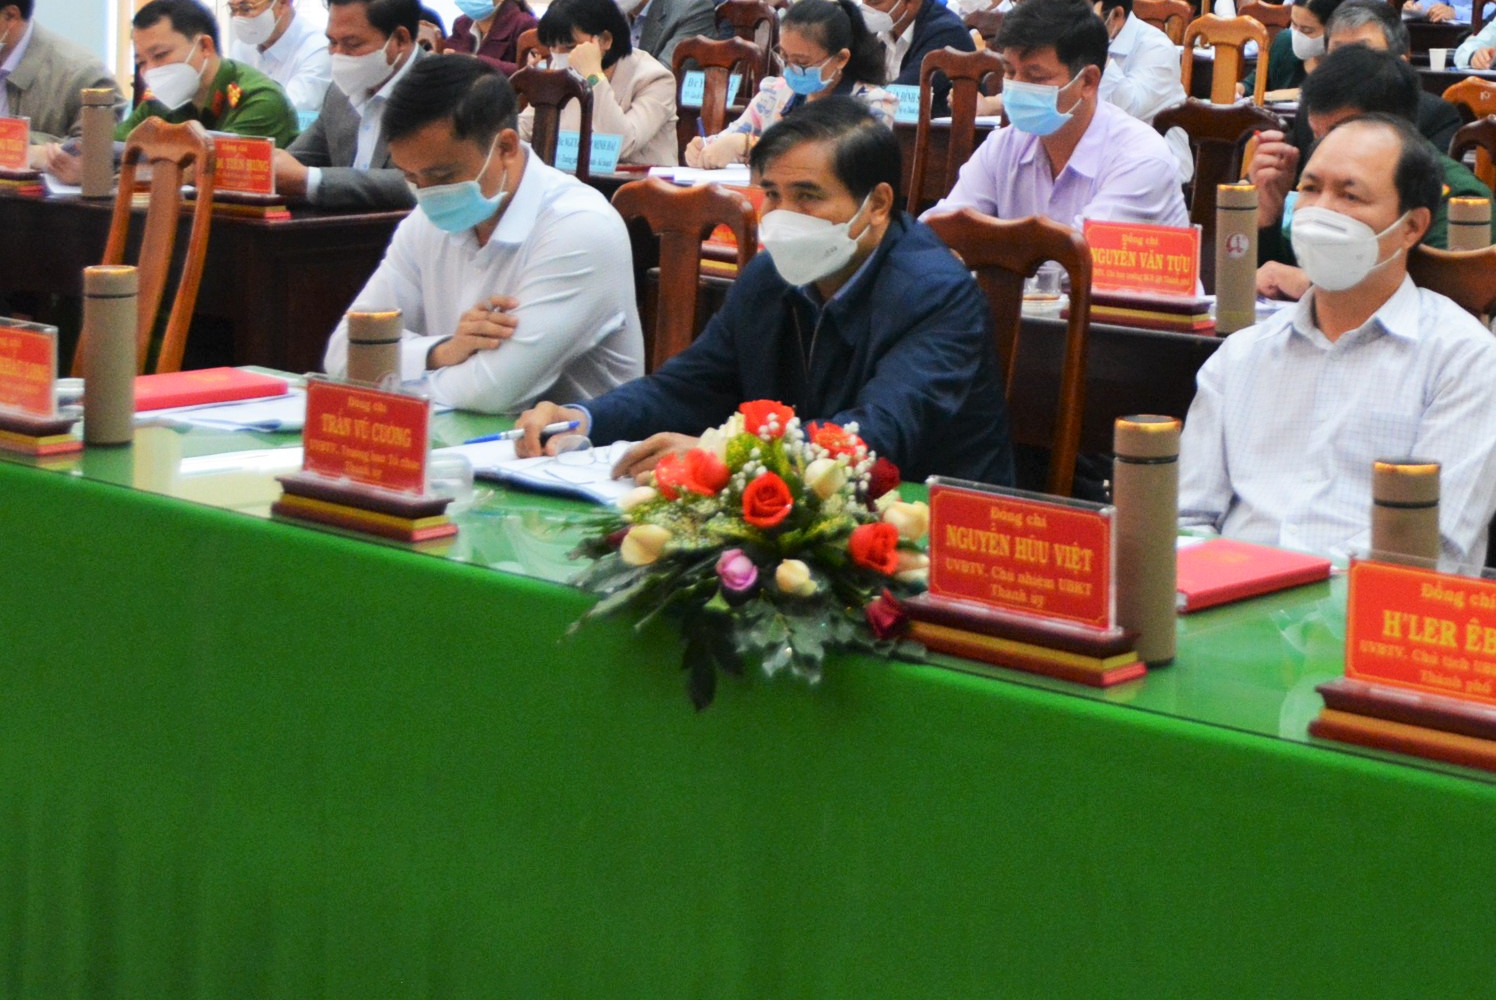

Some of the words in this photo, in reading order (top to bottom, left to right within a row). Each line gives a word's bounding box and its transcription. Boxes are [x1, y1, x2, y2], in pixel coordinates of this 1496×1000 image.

[1139, 250, 1164, 271] VĂN
[946, 522, 1011, 558] NGUYỄN
[1053, 541, 1094, 575] VIỆT
